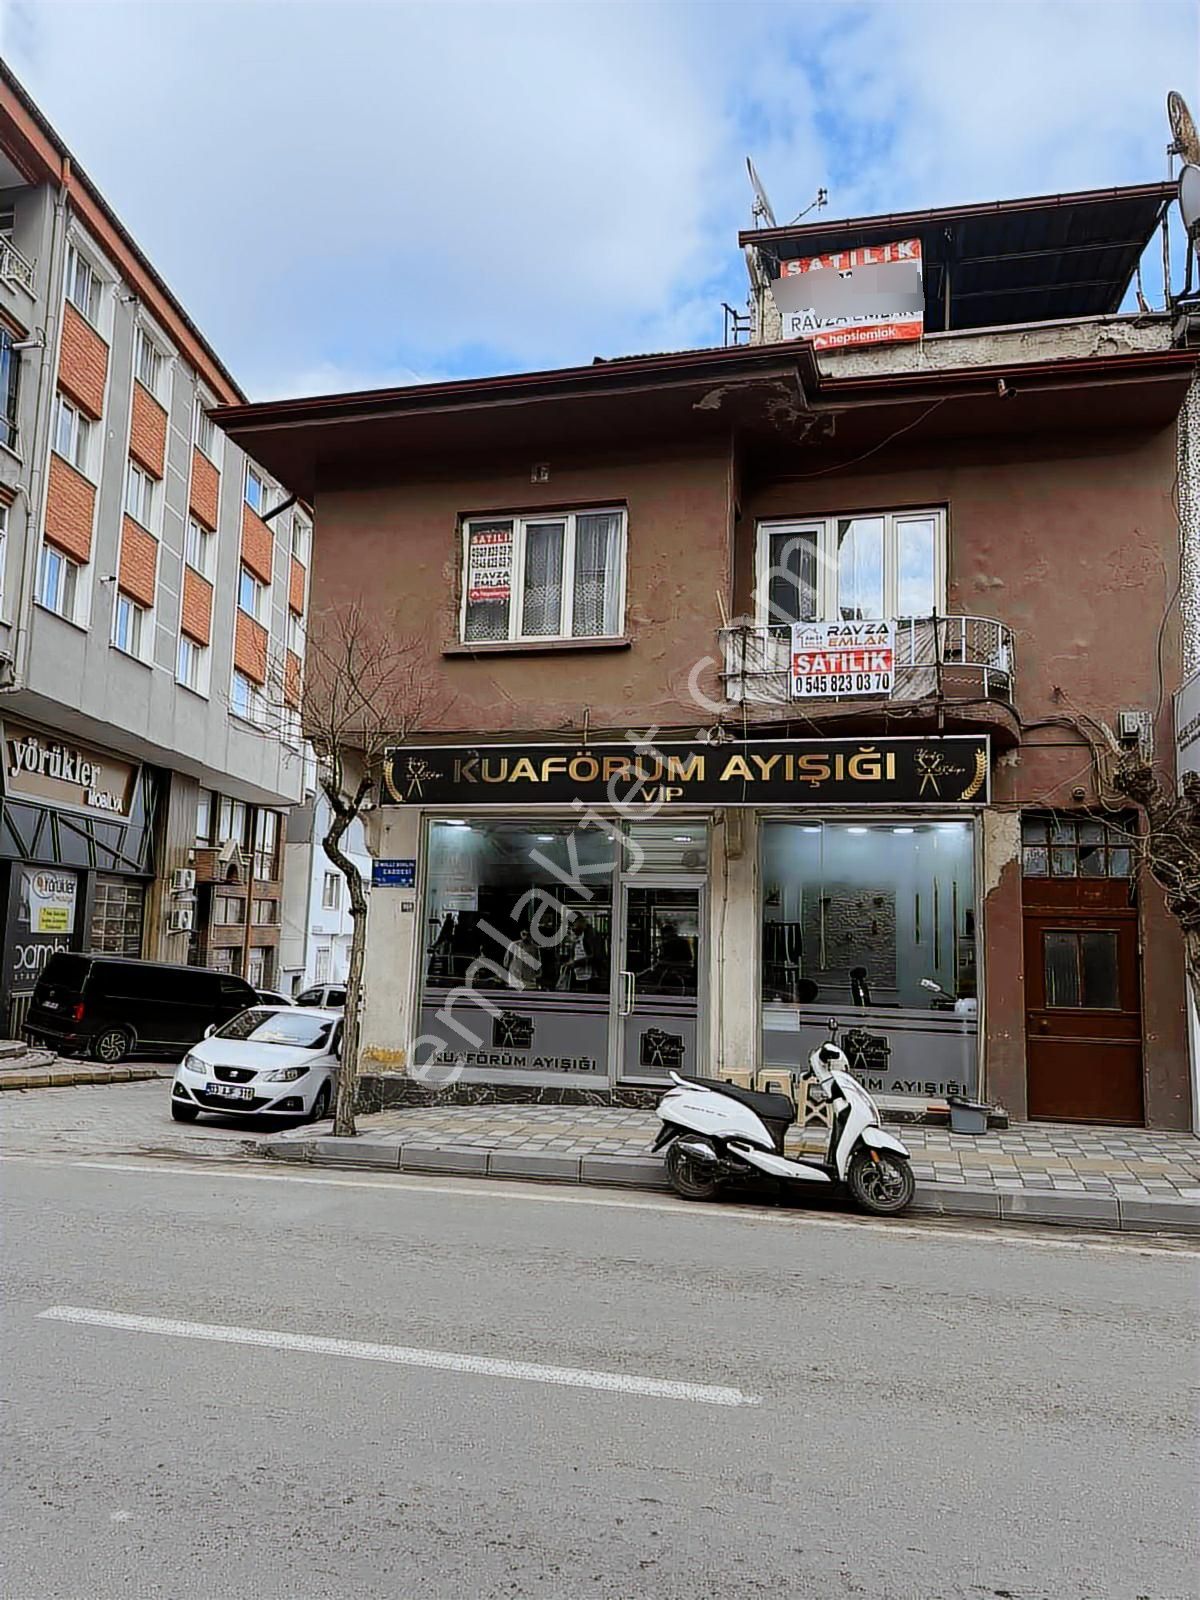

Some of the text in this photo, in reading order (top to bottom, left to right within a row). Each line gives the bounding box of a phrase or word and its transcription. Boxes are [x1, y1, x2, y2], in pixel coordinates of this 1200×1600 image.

[787, 241, 915, 276] SATILIK
[829, 328, 897, 346] hepsiemlak
[474, 571, 510, 579] RAVZA
[827, 623, 889, 637] RAVZA
[829, 635, 887, 647] EMLAK
[797, 651, 887, 673] SATILIK
[796, 673, 889, 693] 0 545 823 03 70
[11, 736, 102, 788] yörükler
[453, 750, 705, 783] KUAFÖRÜM
[719, 746, 895, 788] AYIŞIĞI
[532, 1056, 597, 1073] AYIŞIĞI
[890, 1080, 968, 1097] AYIŞIĞI
